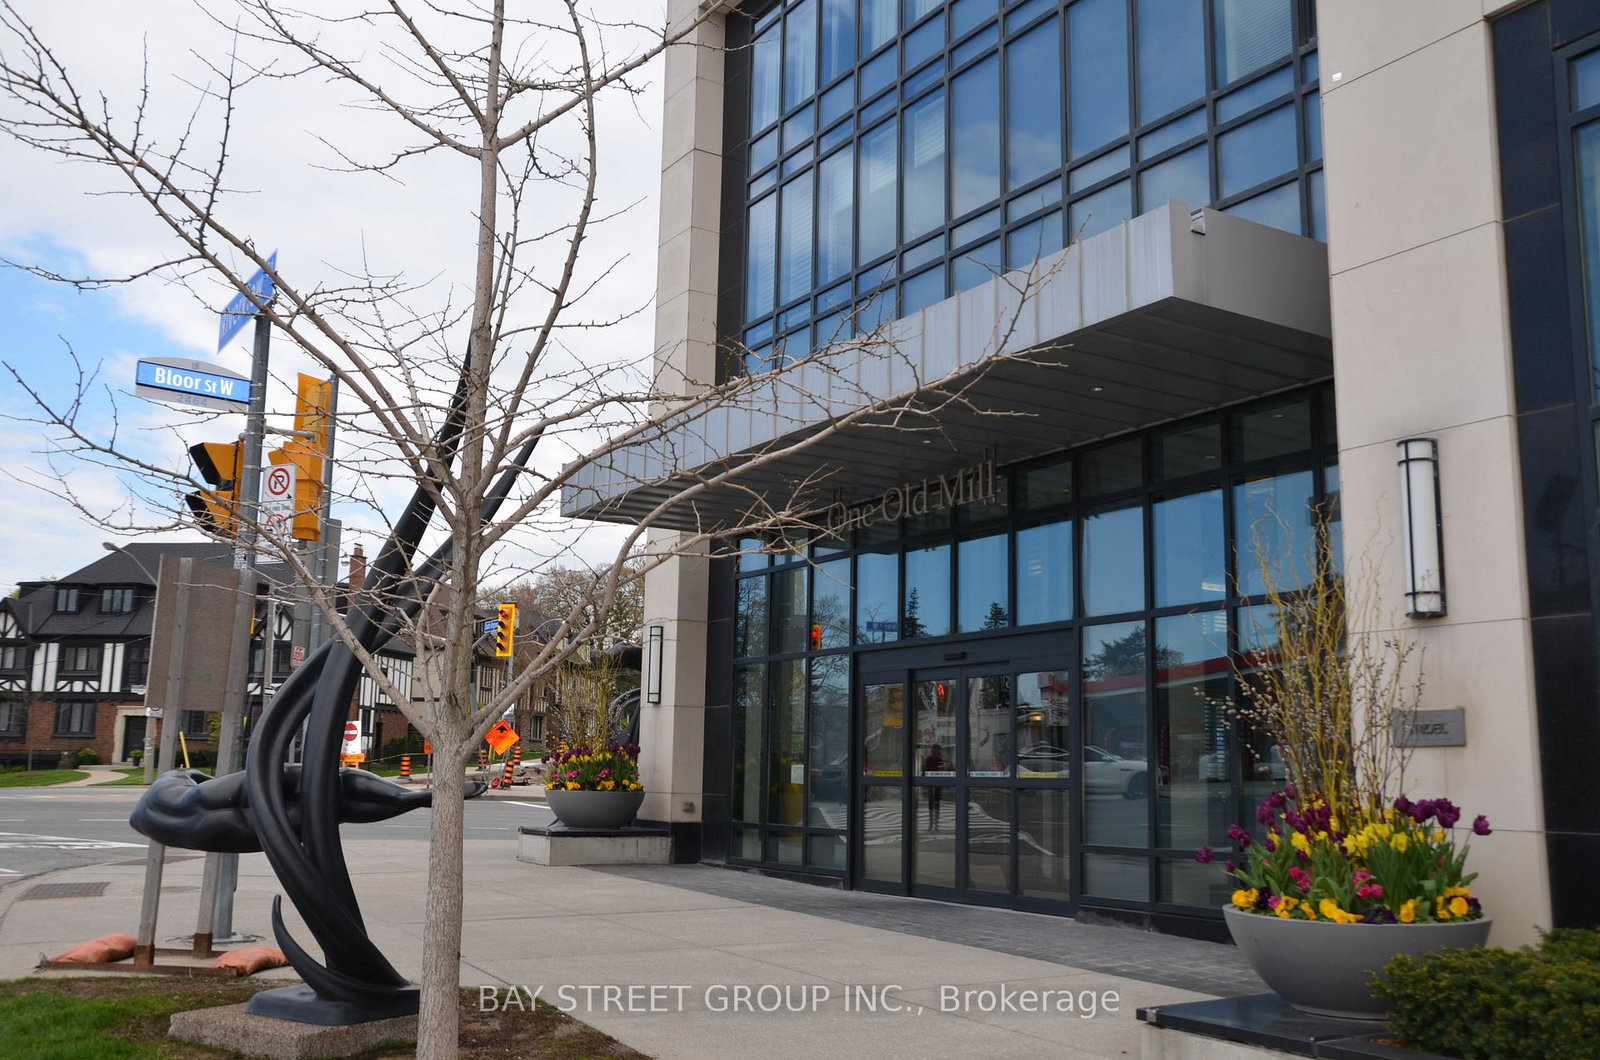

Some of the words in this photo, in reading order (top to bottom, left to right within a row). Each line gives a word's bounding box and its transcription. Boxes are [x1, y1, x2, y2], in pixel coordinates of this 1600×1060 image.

[155, 367, 201, 390] Bloor
[204, 380, 218, 393] St
[220, 379, 234, 396] W
[827, 501, 874, 534] One
[882, 478, 929, 522] Old
[934, 460, 994, 510] Mill
